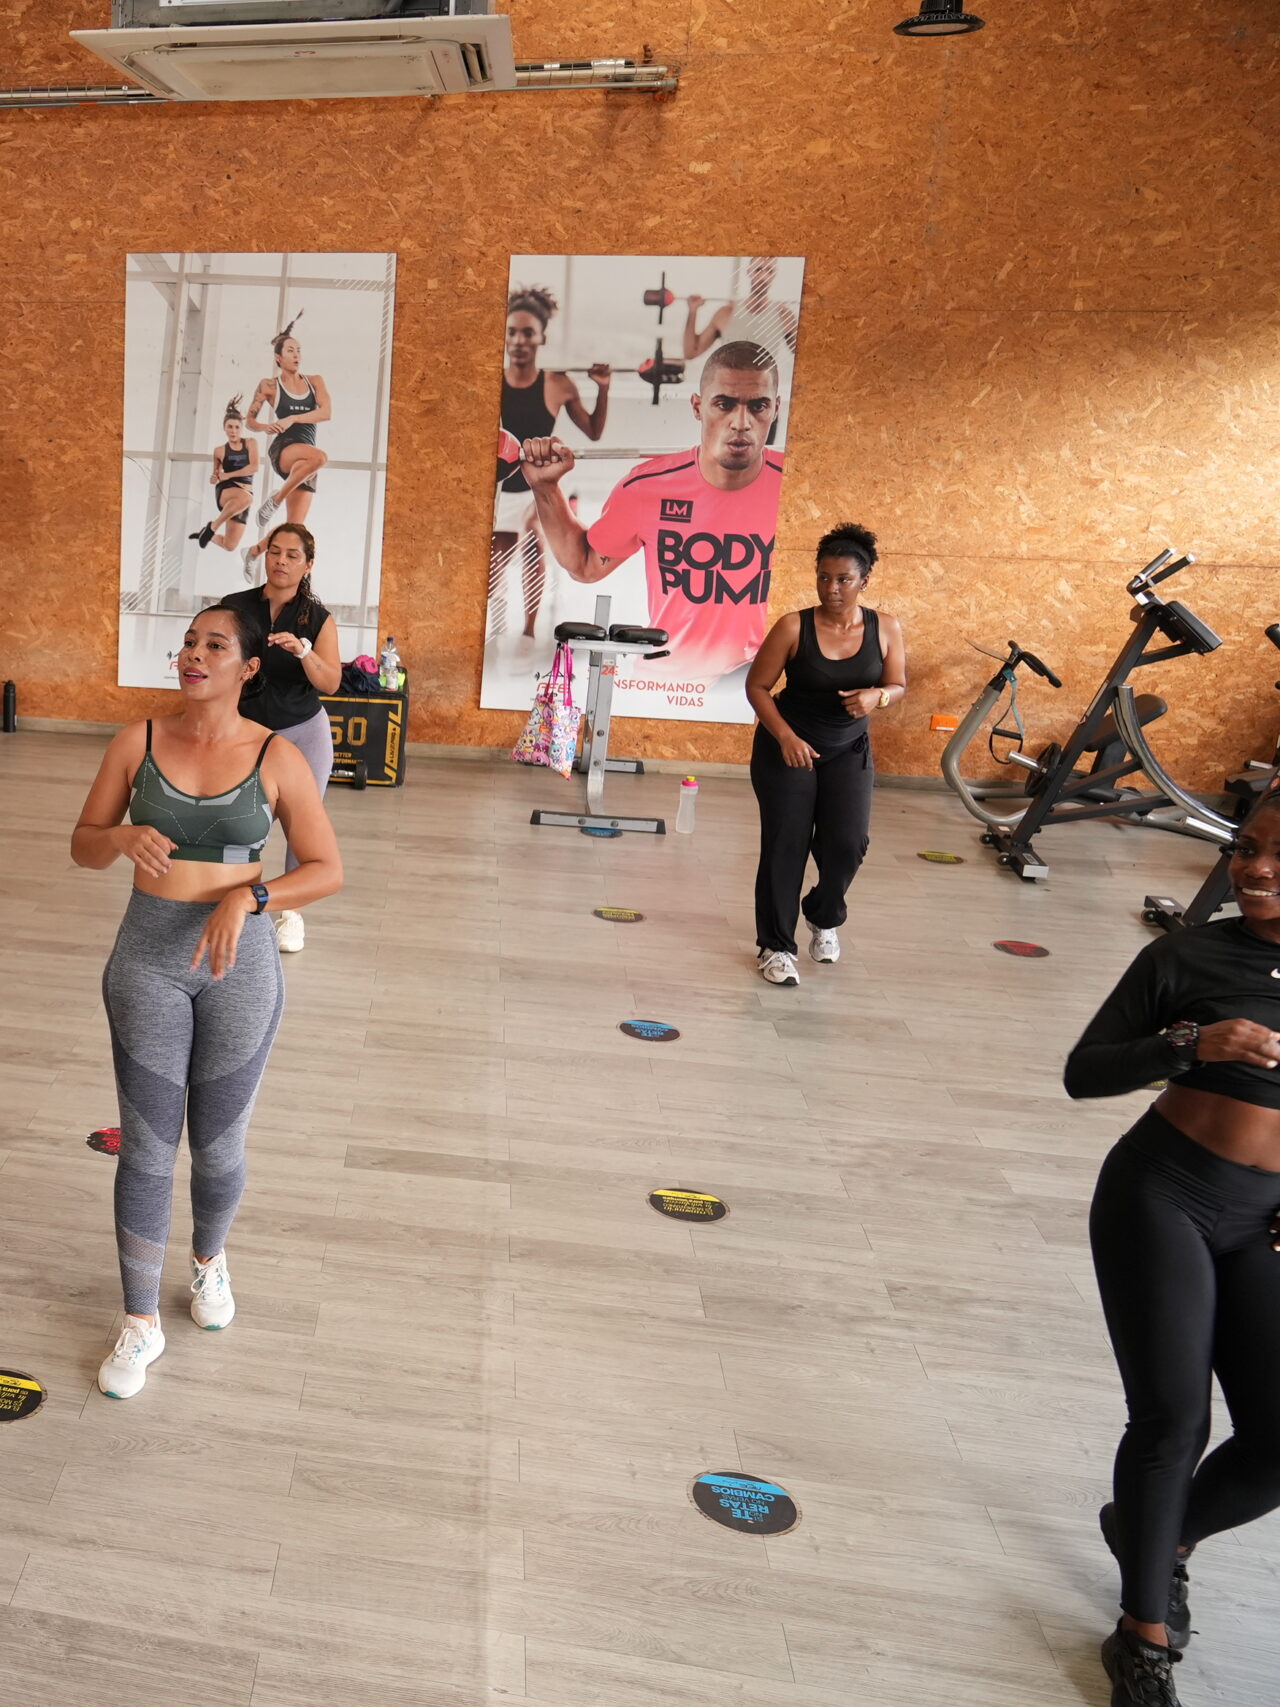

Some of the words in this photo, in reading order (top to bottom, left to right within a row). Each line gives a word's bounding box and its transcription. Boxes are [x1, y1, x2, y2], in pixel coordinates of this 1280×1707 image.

[665, 501, 689, 516] LM
[657, 529, 776, 571] BODY
[613, 679, 706, 695] NSFORMANDO
[666, 695, 705, 708] VIDAS
[710, 1485, 776, 1502] CAMBIOS
[719, 1498, 770, 1514] RETAS
[731, 1507, 754, 1521] TE
